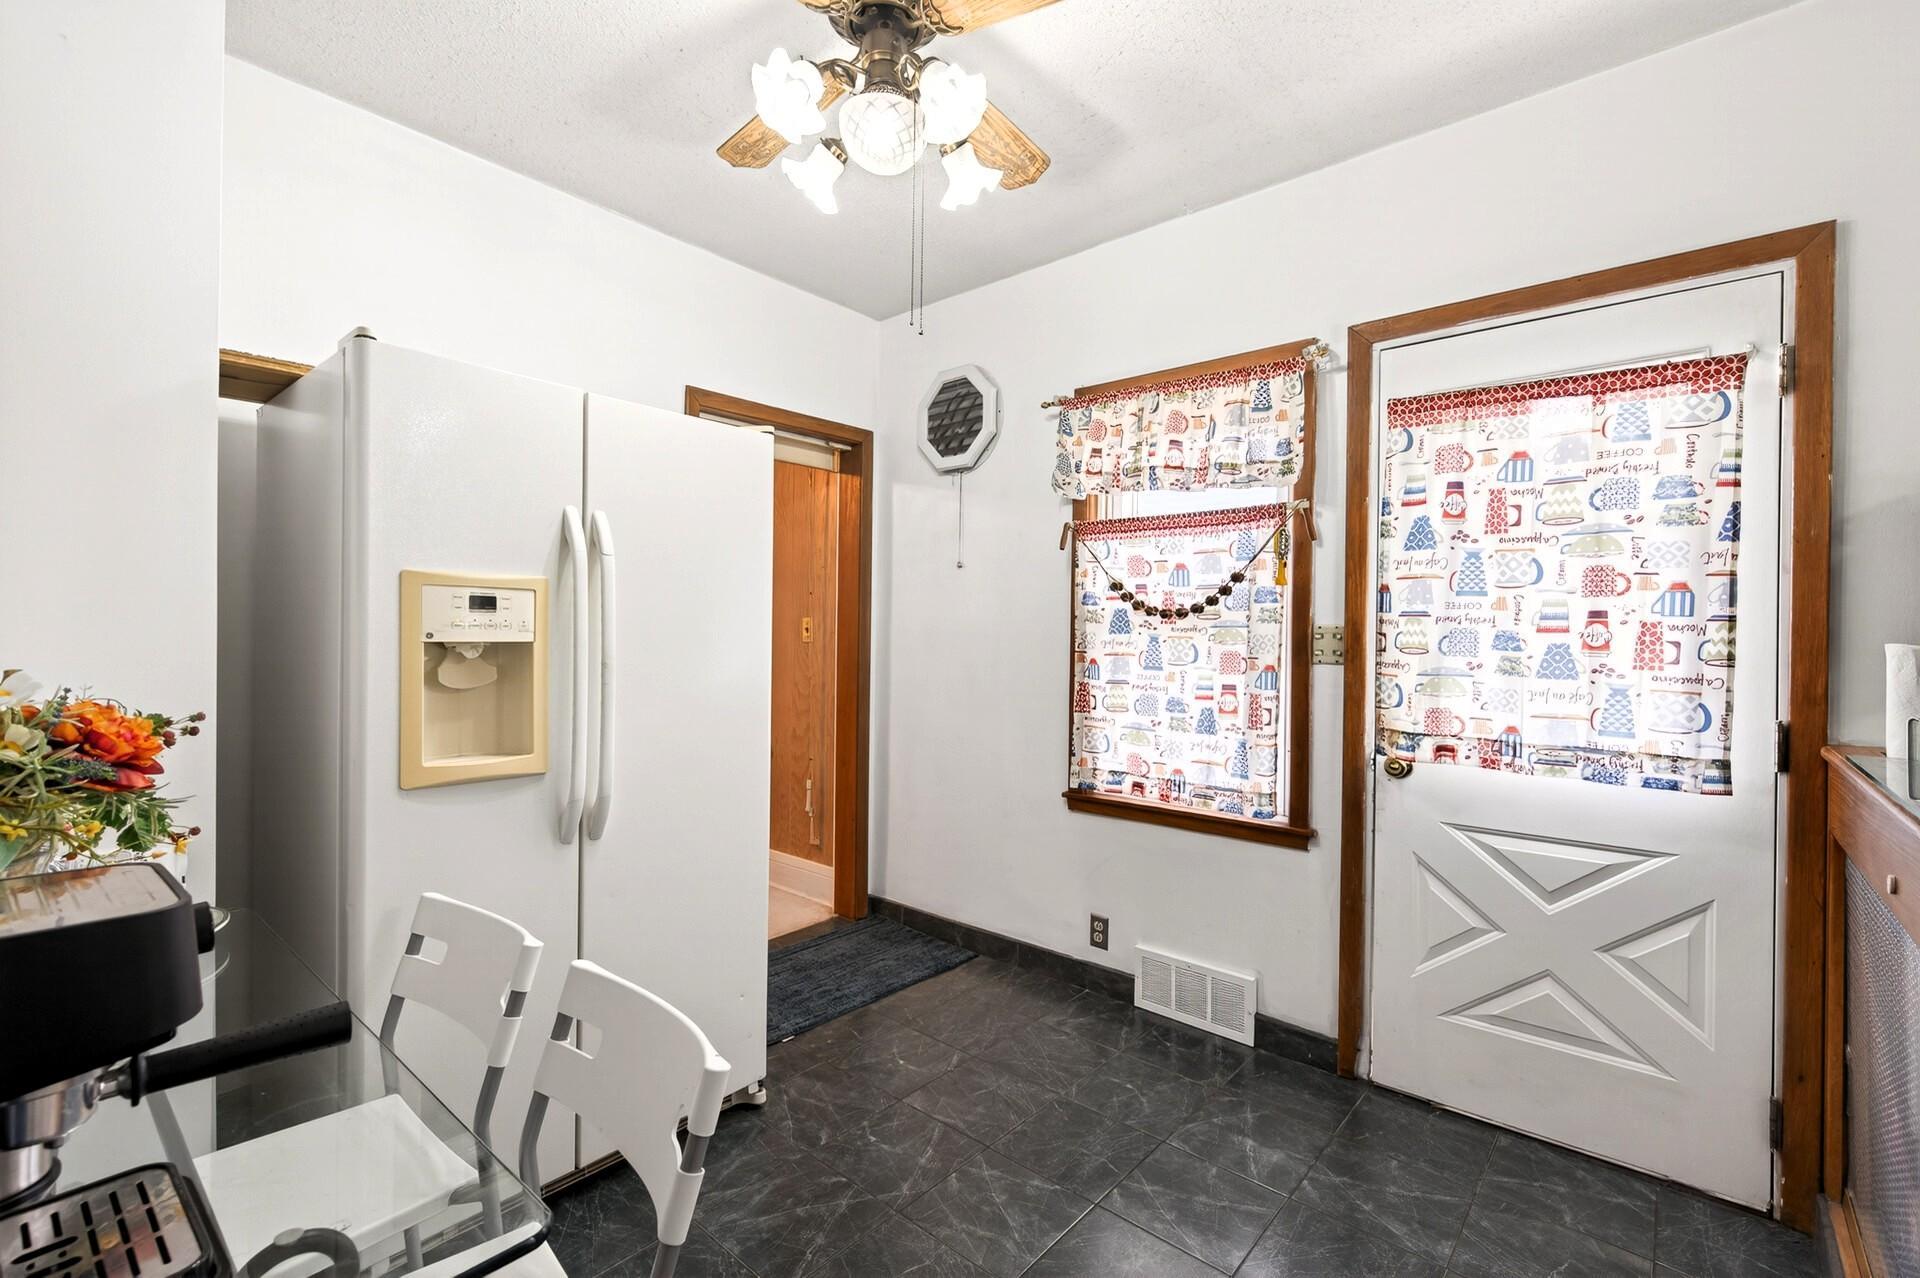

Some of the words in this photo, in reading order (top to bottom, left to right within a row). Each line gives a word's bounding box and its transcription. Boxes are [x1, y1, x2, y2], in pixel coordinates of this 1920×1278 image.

[1596, 448, 1644, 460] COFFEE
[1444, 601, 1482, 611] COFFEE
[1578, 629, 1613, 645] Coffee
[1651, 673, 1725, 690] Cappuccino
